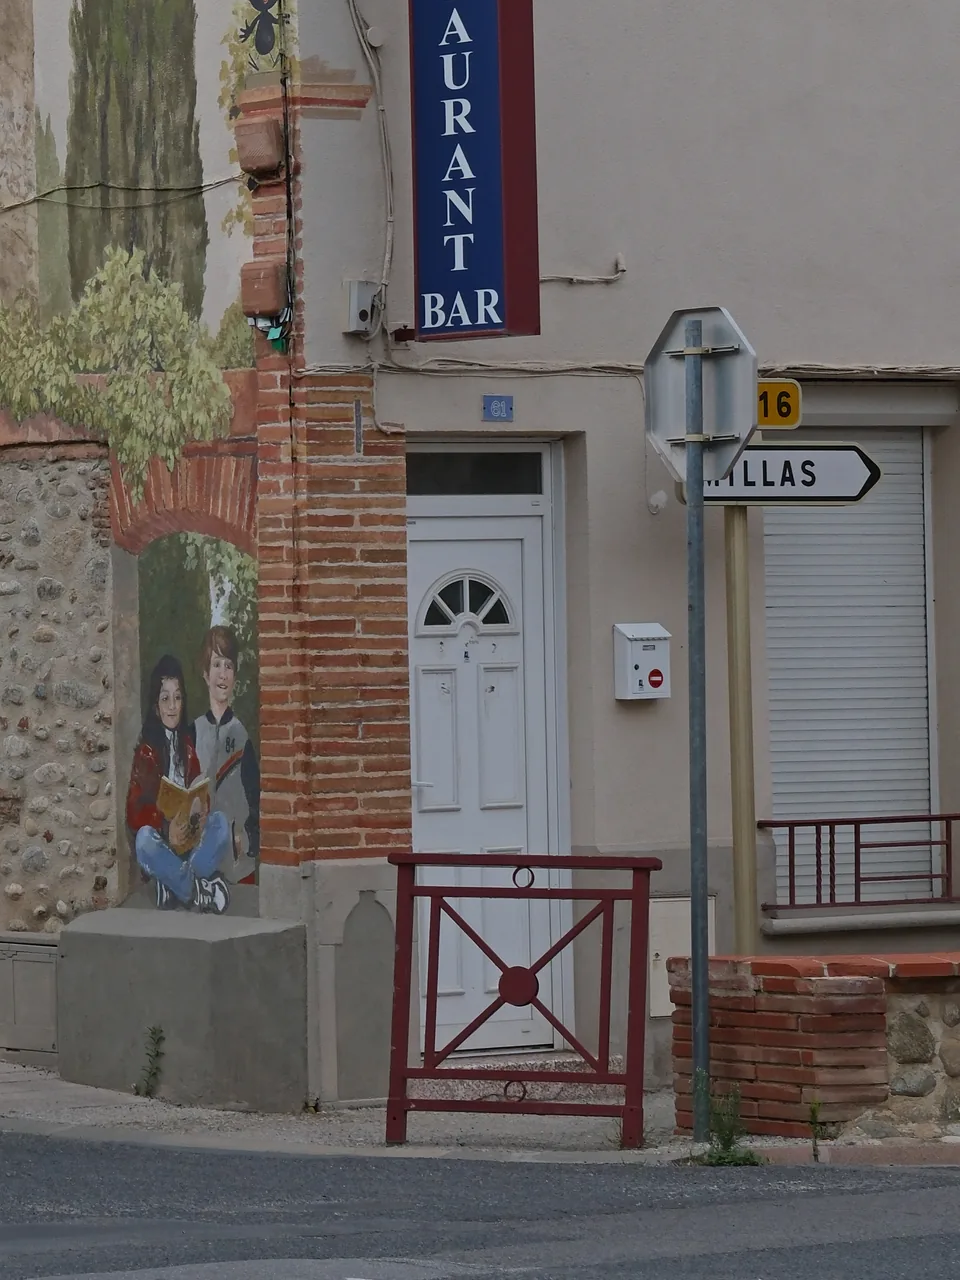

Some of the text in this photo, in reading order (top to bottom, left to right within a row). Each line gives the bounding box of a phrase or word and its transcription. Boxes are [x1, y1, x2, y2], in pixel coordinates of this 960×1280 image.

[421, 288, 503, 329] BAR
[758, 390, 792, 418] 16
[706, 460, 817, 488] ILLAS
